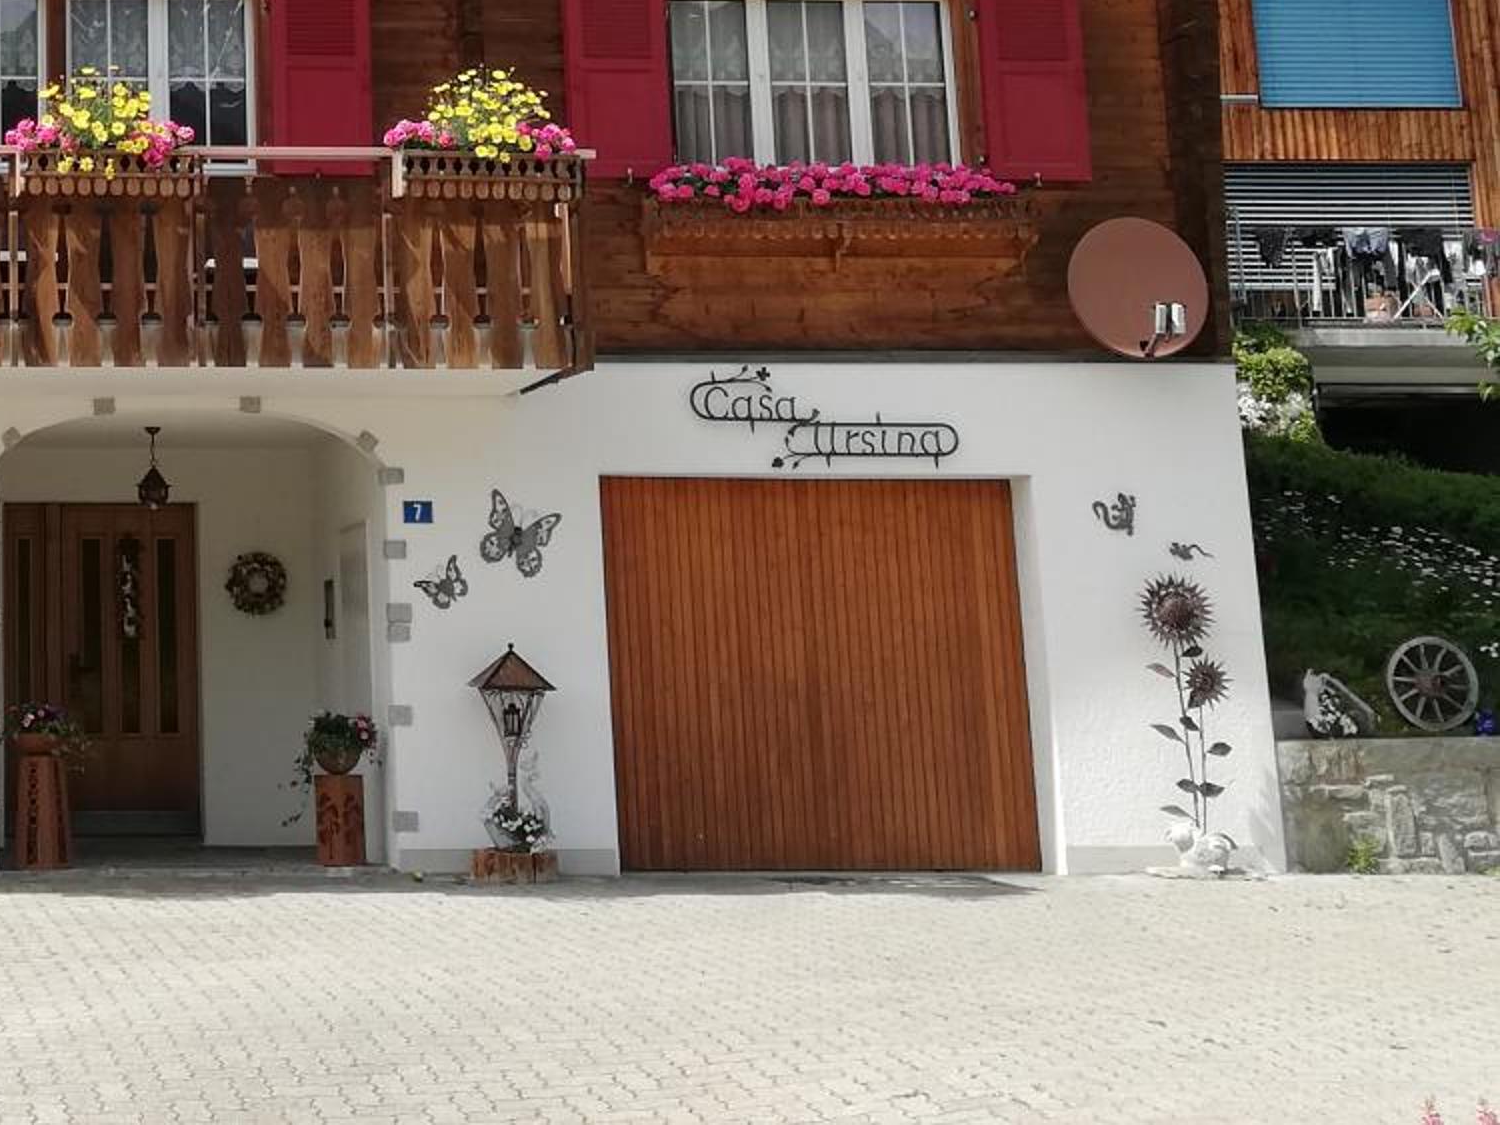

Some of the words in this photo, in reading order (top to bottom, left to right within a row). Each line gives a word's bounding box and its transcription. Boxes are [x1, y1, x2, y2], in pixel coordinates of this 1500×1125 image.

[703, 385, 799, 421] Casa
[813, 423, 945, 457] Ursina
[413, 504, 422, 522] 7
